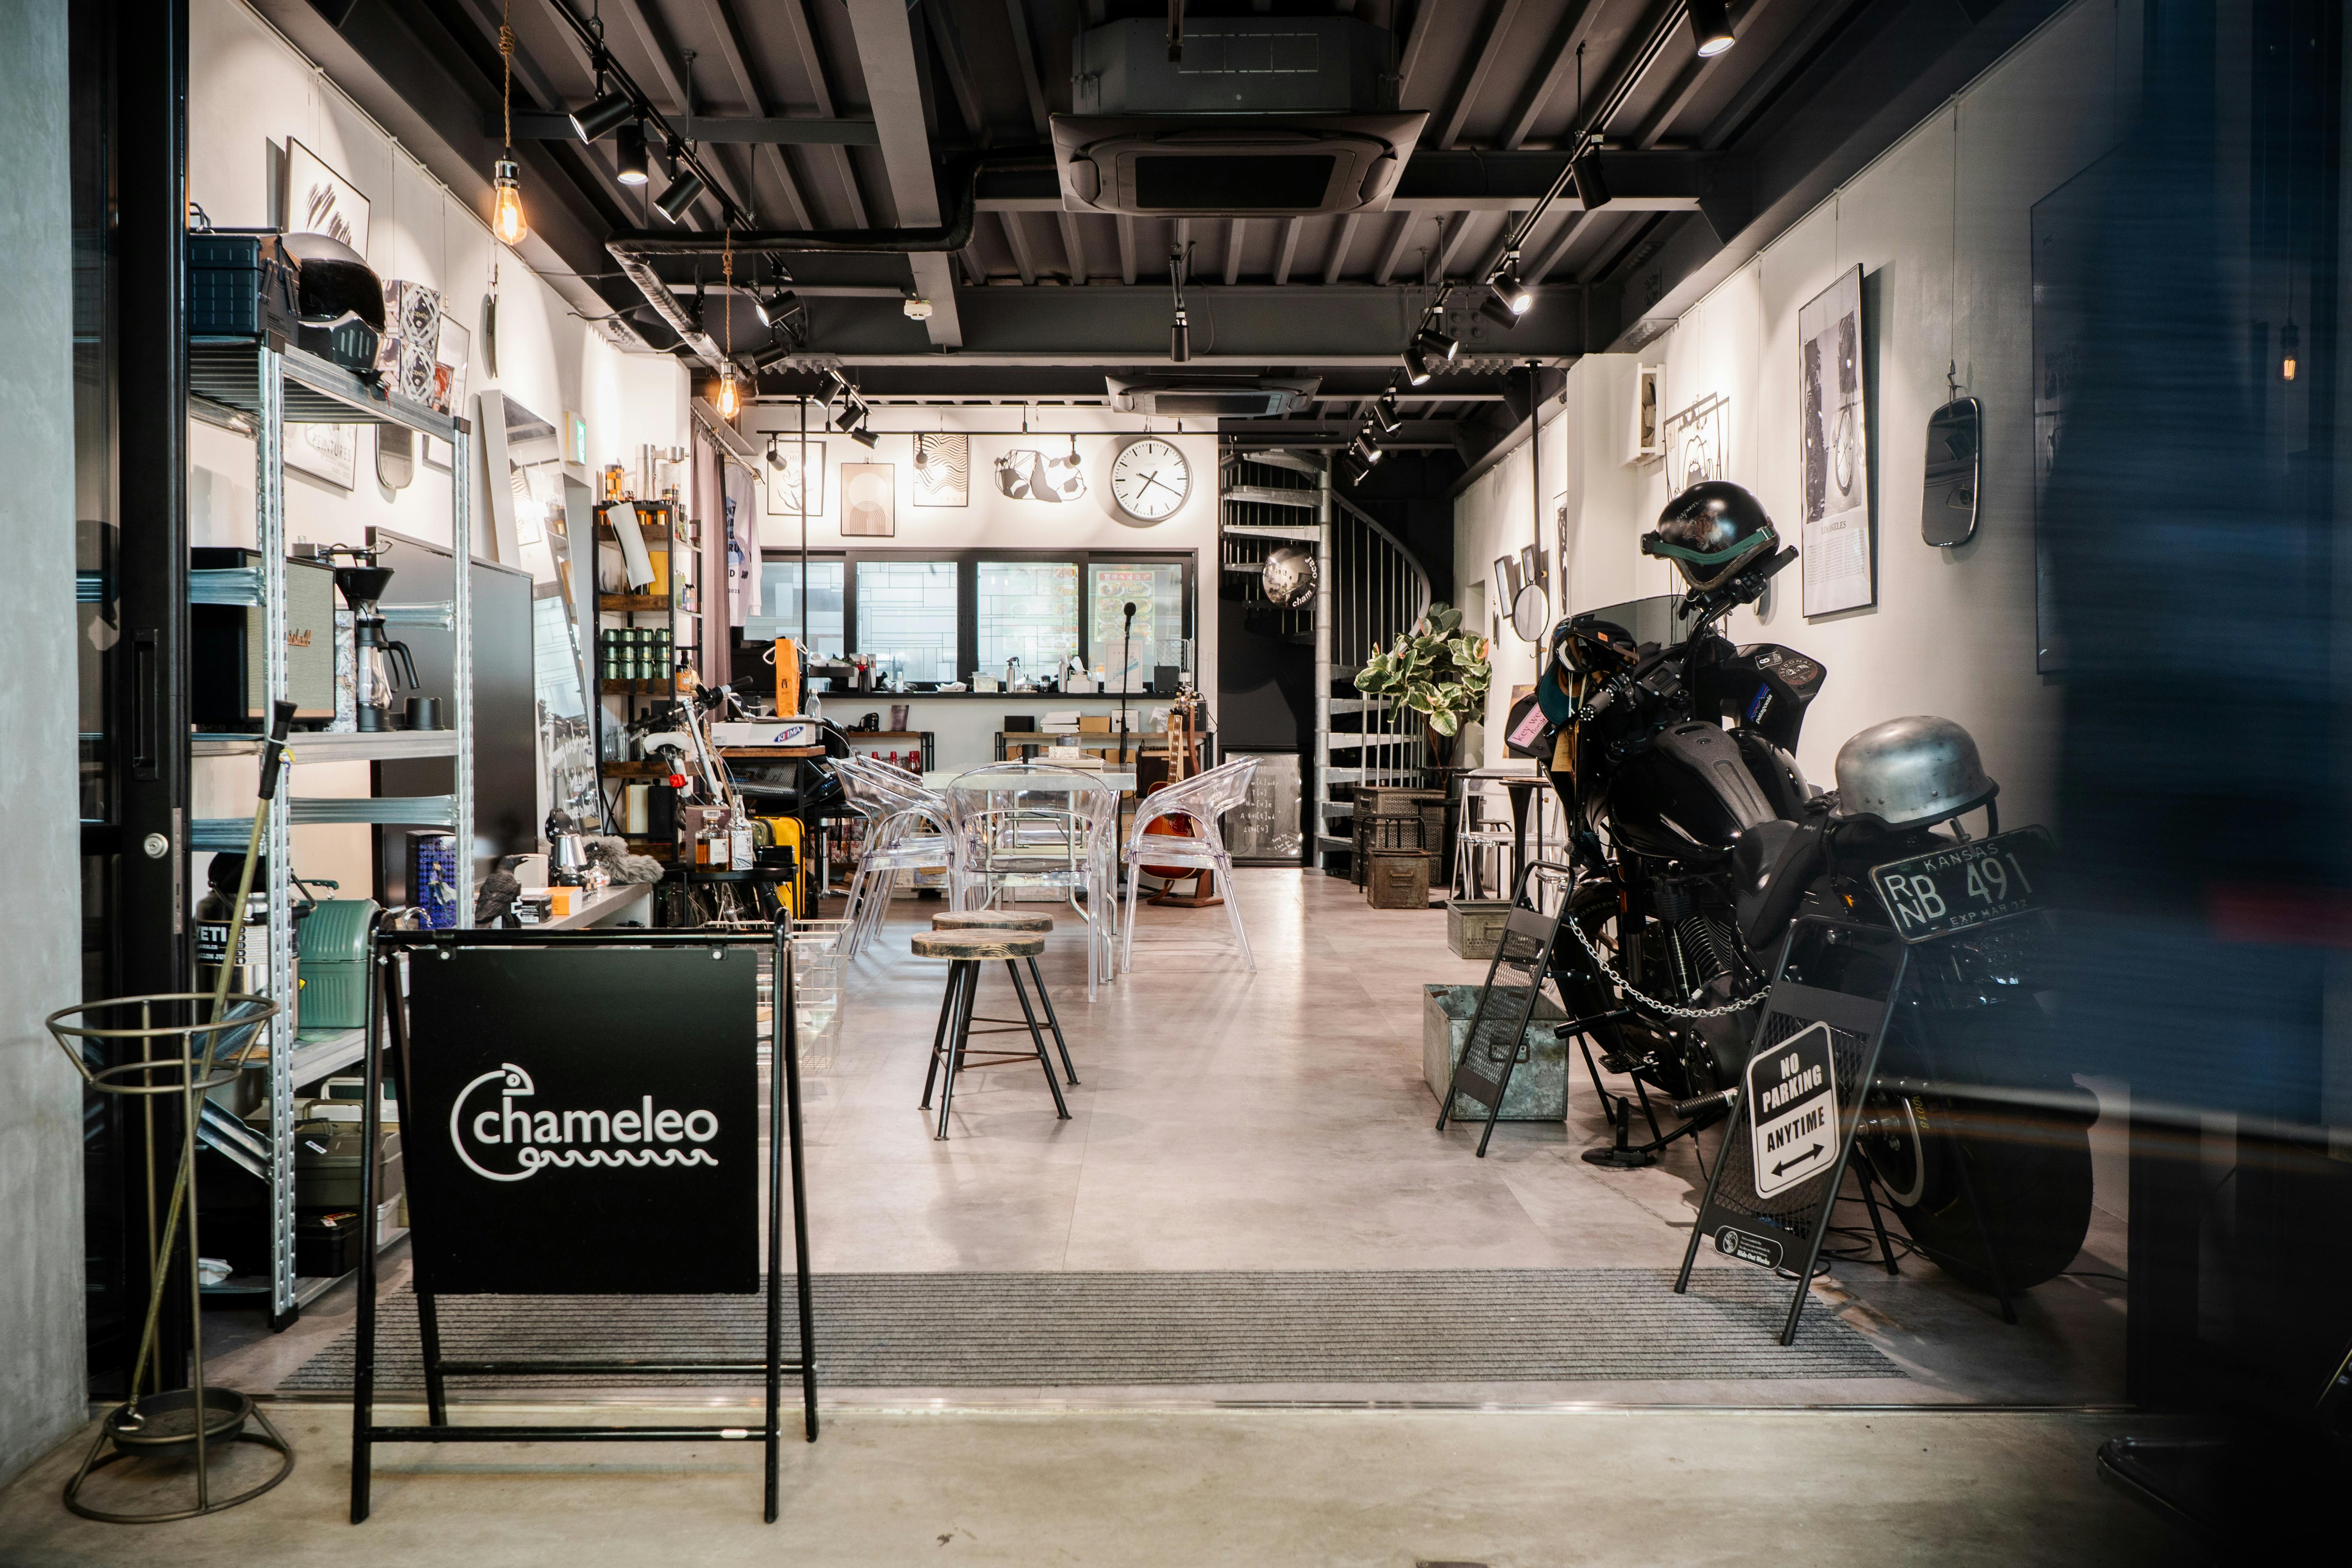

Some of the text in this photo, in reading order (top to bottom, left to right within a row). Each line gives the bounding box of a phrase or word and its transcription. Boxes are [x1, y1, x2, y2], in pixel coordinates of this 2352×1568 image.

[1780, 659, 1808, 674] SEDONA
[1756, 694, 1772, 724] patagonia
[1513, 709, 1542, 741] key we
[1924, 843, 1998, 872] KANSAS
[1967, 852, 2033, 904] 491
[1950, 912, 1976, 925] EXP
[1981, 904, 2008, 917] MAR
[1780, 1053, 1799, 1079] NO
[1763, 1064, 1822, 1113] PARKING
[473, 1095, 719, 1143] chameleo
[1768, 1106, 1825, 1153] ANYTIME
